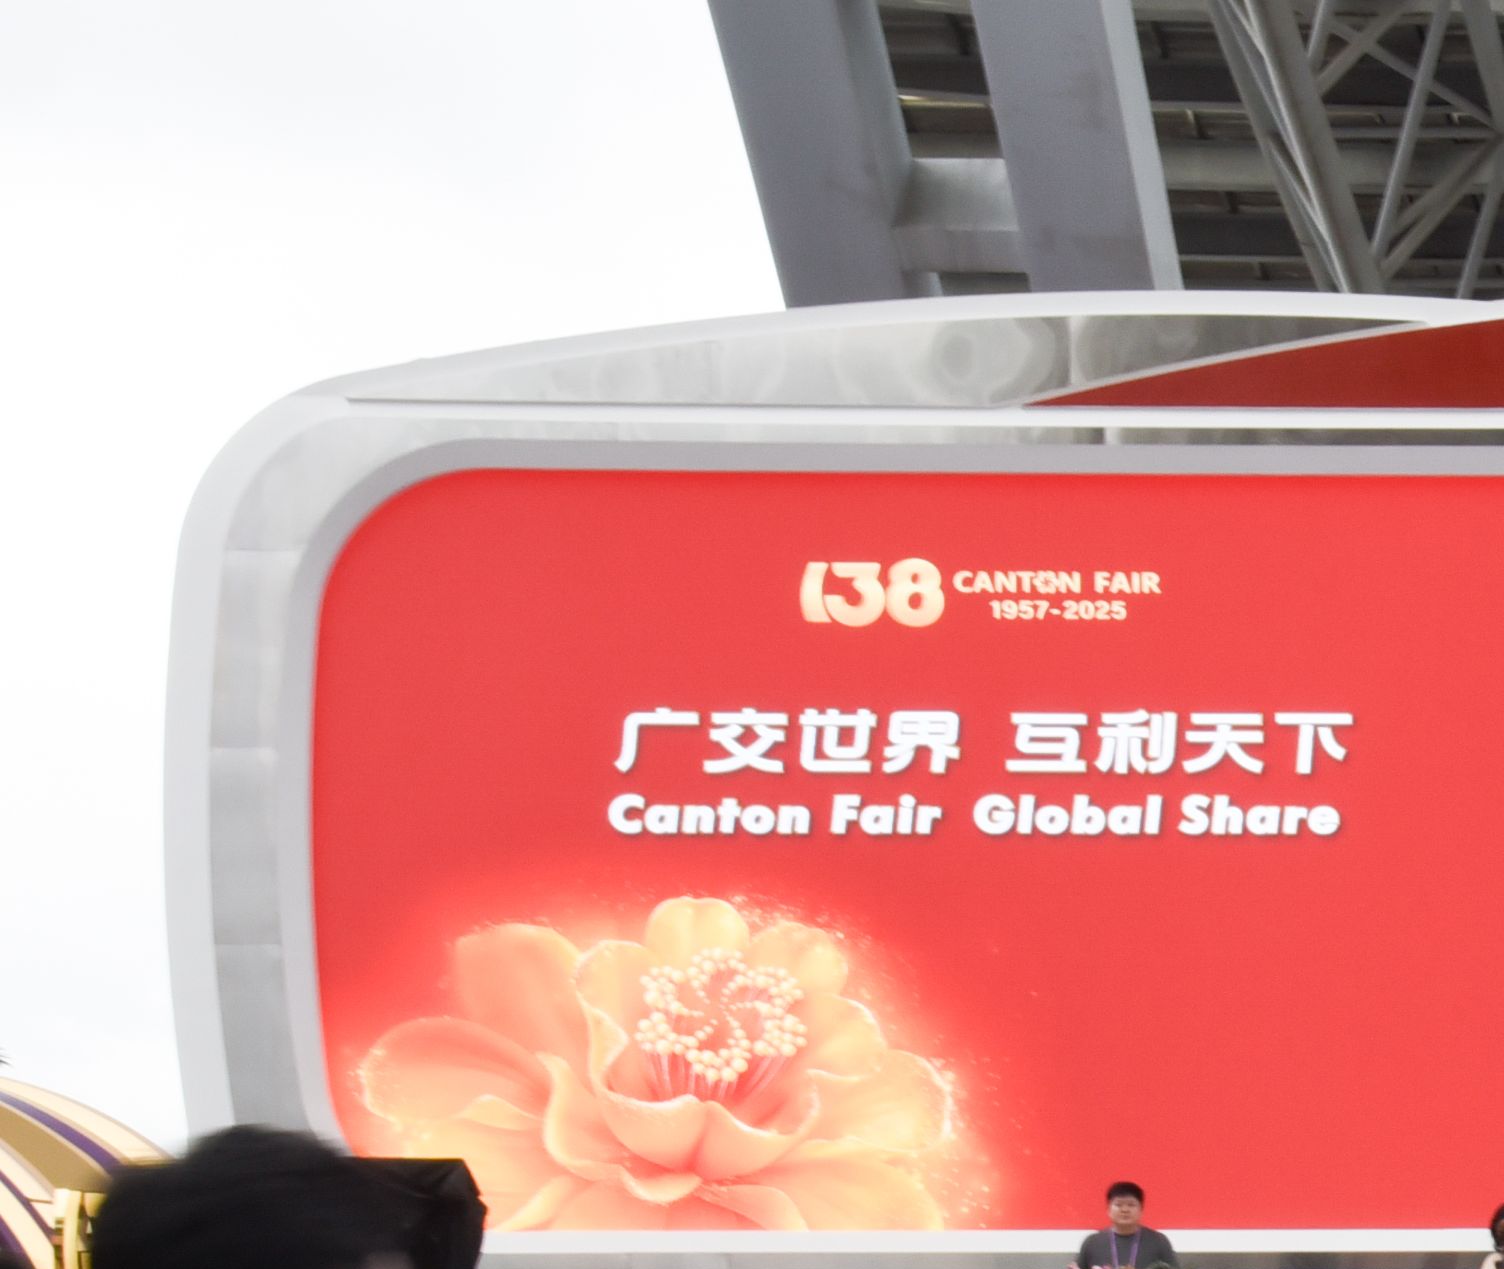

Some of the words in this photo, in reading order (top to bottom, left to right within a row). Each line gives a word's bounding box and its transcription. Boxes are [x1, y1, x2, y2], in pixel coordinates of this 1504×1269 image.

[800, 558, 945, 627] 138
[953, 571, 1081, 594] CANTON
[1094, 571, 1161, 594] FAIR
[989, 600, 1127, 620] 1957-2025
[614, 707, 960, 774] 广交世界
[1005, 708, 1353, 774] 互利天下
[608, 793, 810, 834] Canton
[830, 794, 942, 835] Fair
[973, 794, 1163, 835] Global
[1178, 794, 1340, 835] Share
